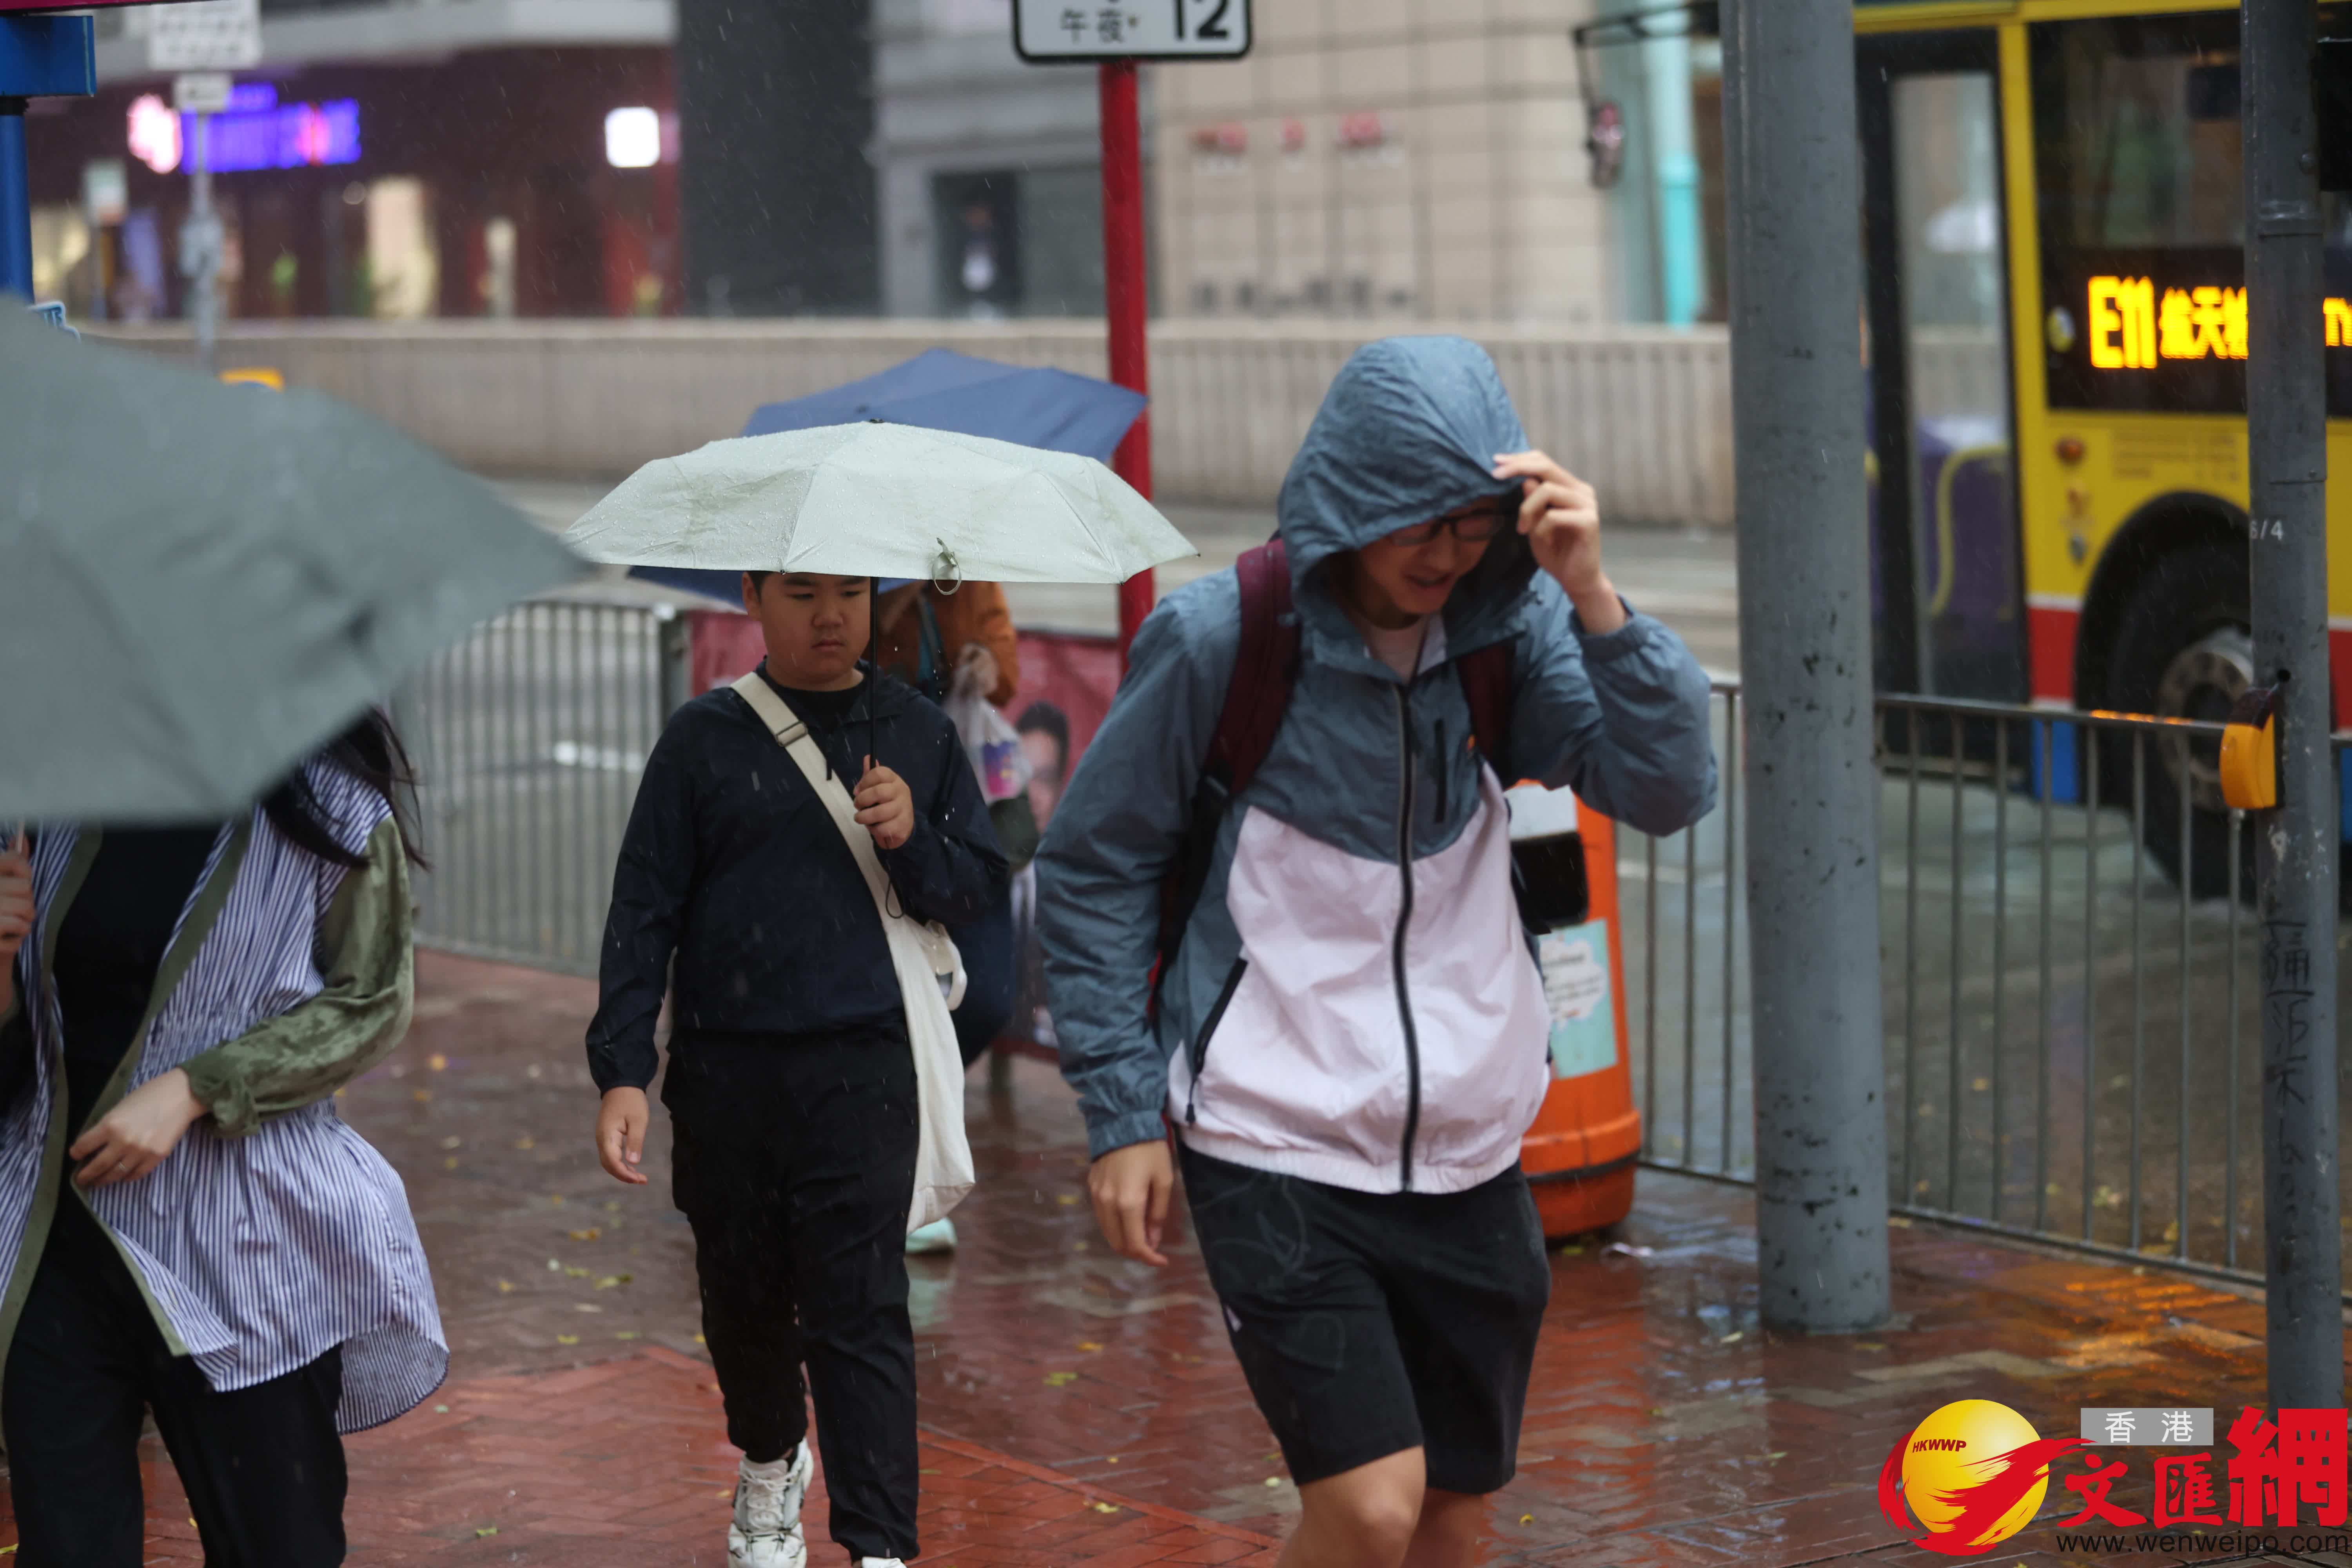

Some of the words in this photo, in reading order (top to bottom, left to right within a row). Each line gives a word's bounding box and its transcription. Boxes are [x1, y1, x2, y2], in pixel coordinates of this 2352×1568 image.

[1060, 9, 1124, 43] 午夜
[1175, 0, 1230, 40] 12
[2087, 276, 2156, 369] E11
